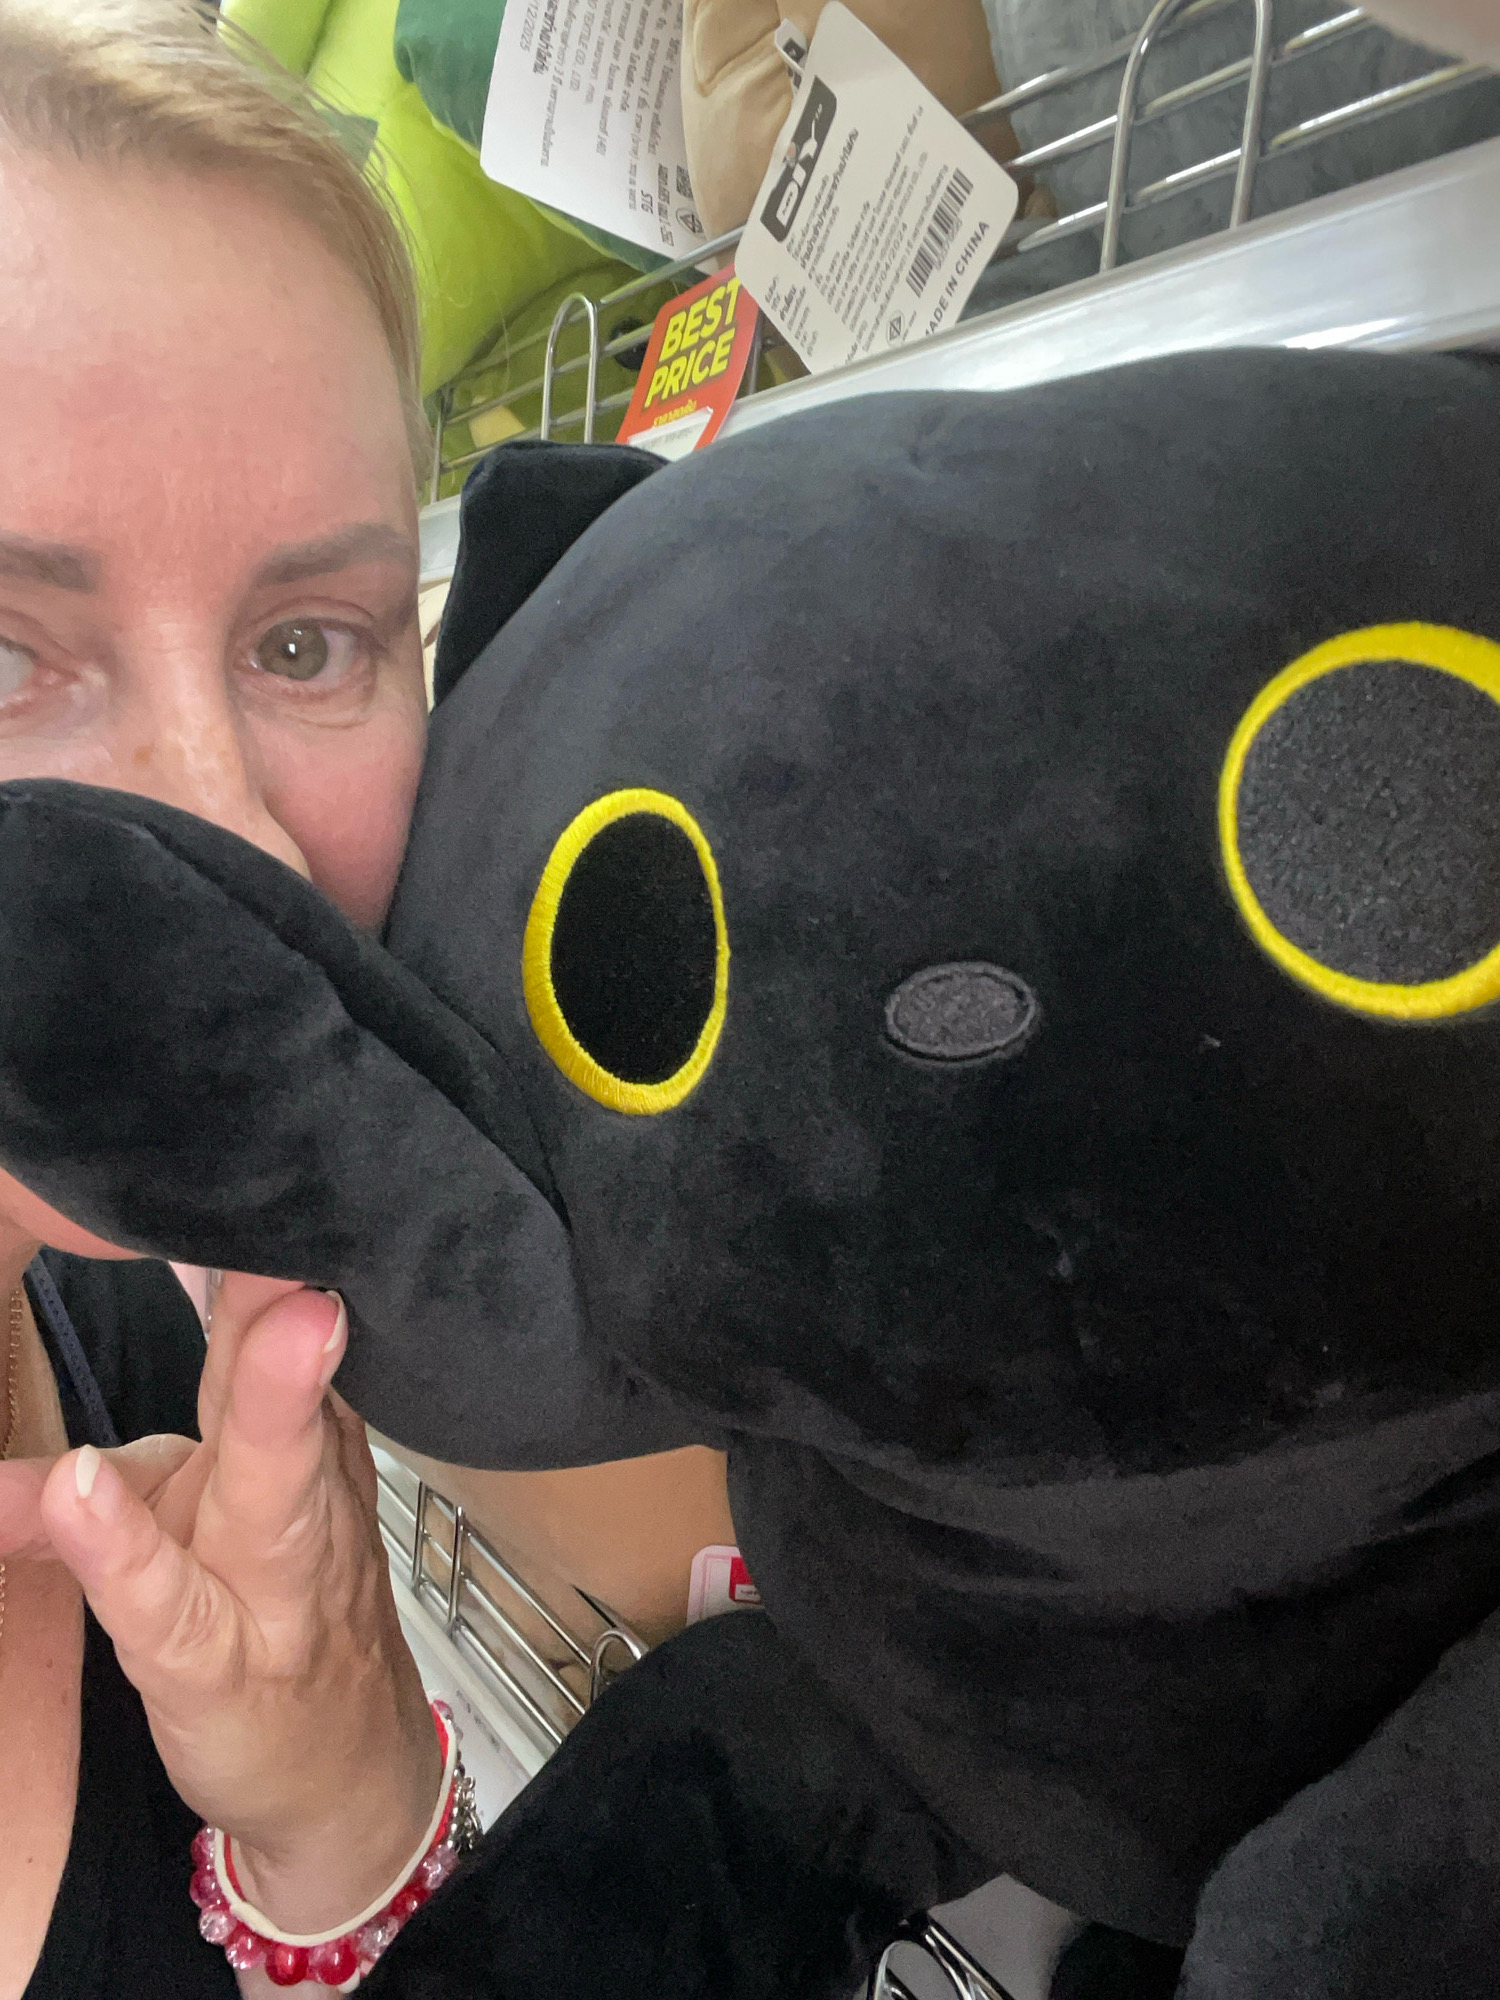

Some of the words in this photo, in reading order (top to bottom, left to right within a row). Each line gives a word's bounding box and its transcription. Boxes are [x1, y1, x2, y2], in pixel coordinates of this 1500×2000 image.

[870, 222, 908, 303] 26/04/2024
[945, 276, 958, 297] IN
[955, 220, 990, 276] CHINA
[658, 276, 742, 362] BEST
[643, 327, 736, 408] PRICE
